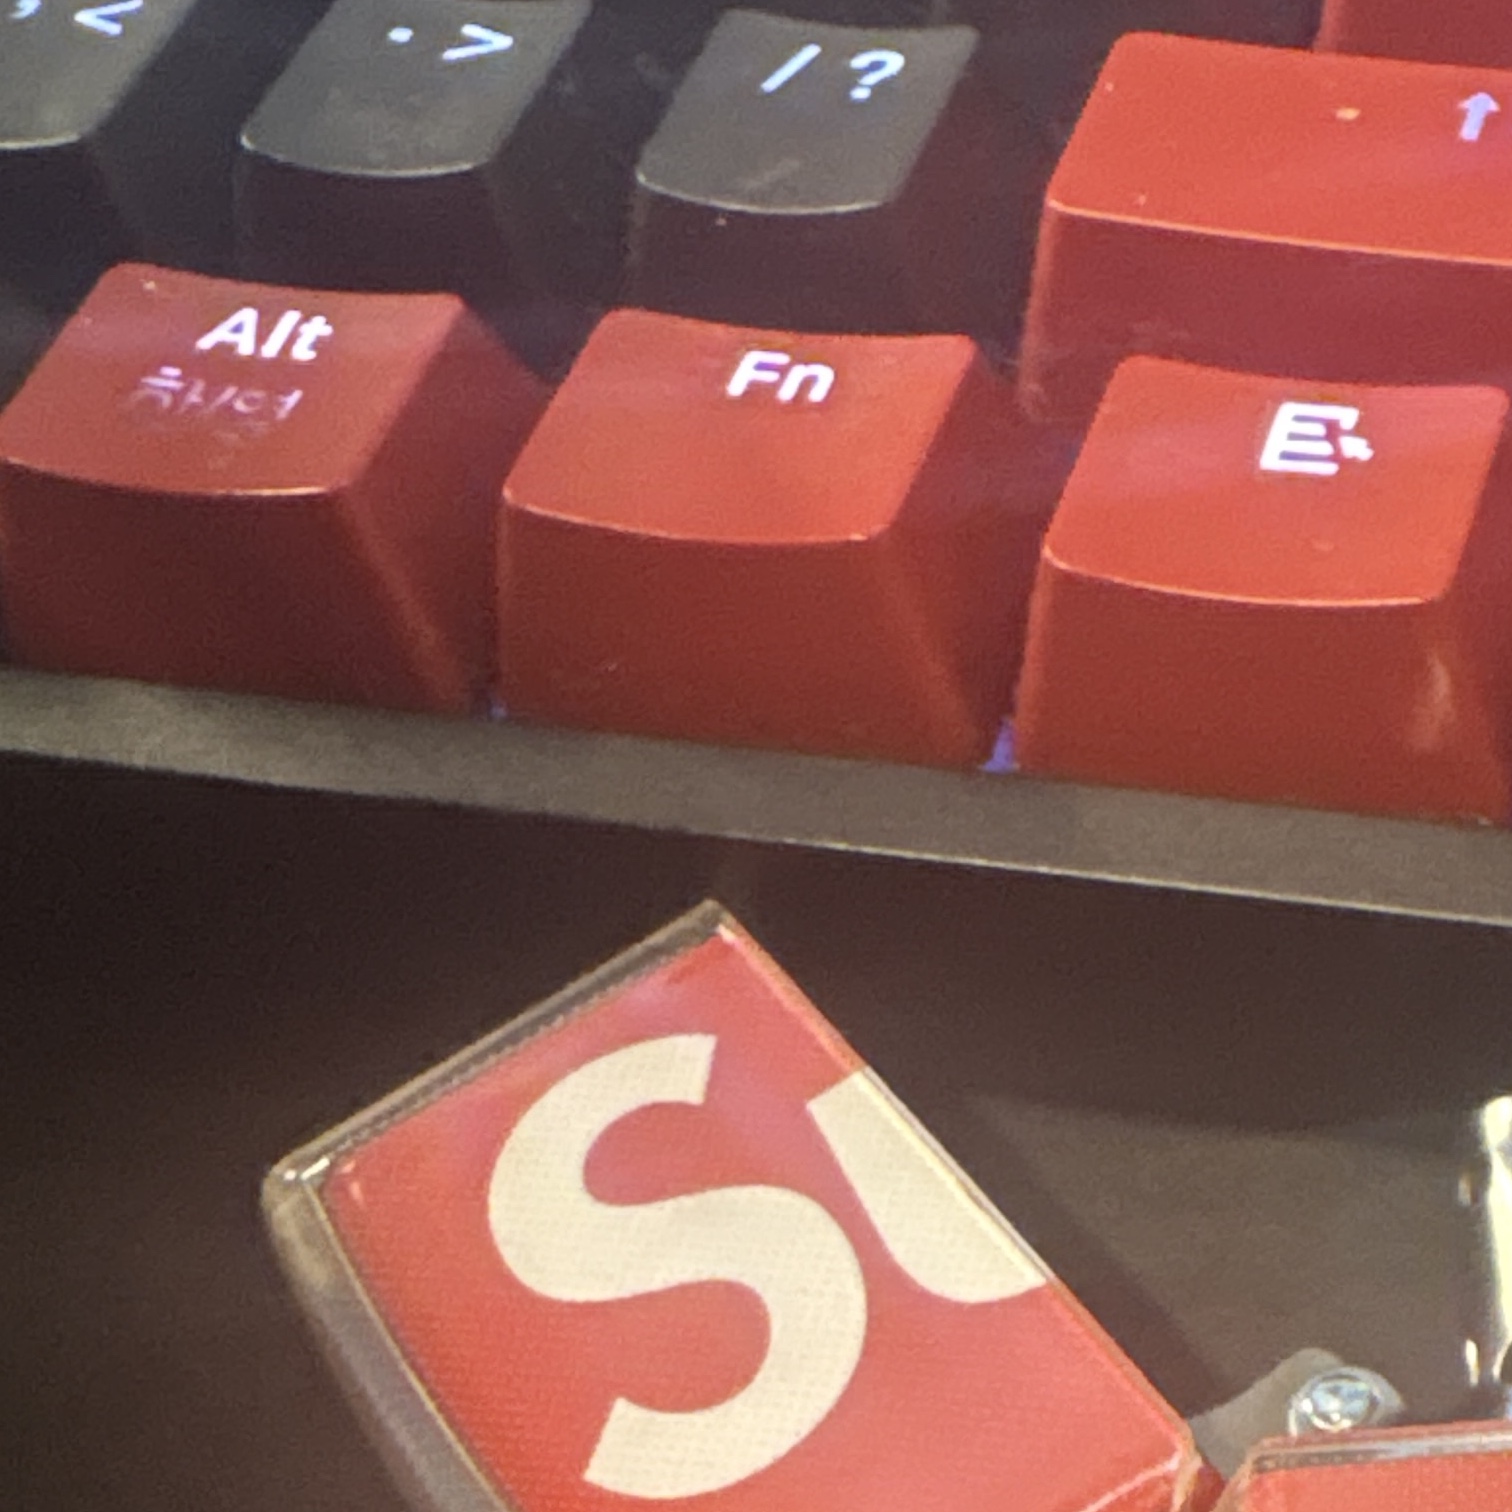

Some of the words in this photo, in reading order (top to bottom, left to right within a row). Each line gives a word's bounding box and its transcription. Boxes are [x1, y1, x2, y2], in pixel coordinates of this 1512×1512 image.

[849, 49, 905, 101] ?
[195, 306, 335, 361] Alt
[726, 350, 835, 403] Fn
